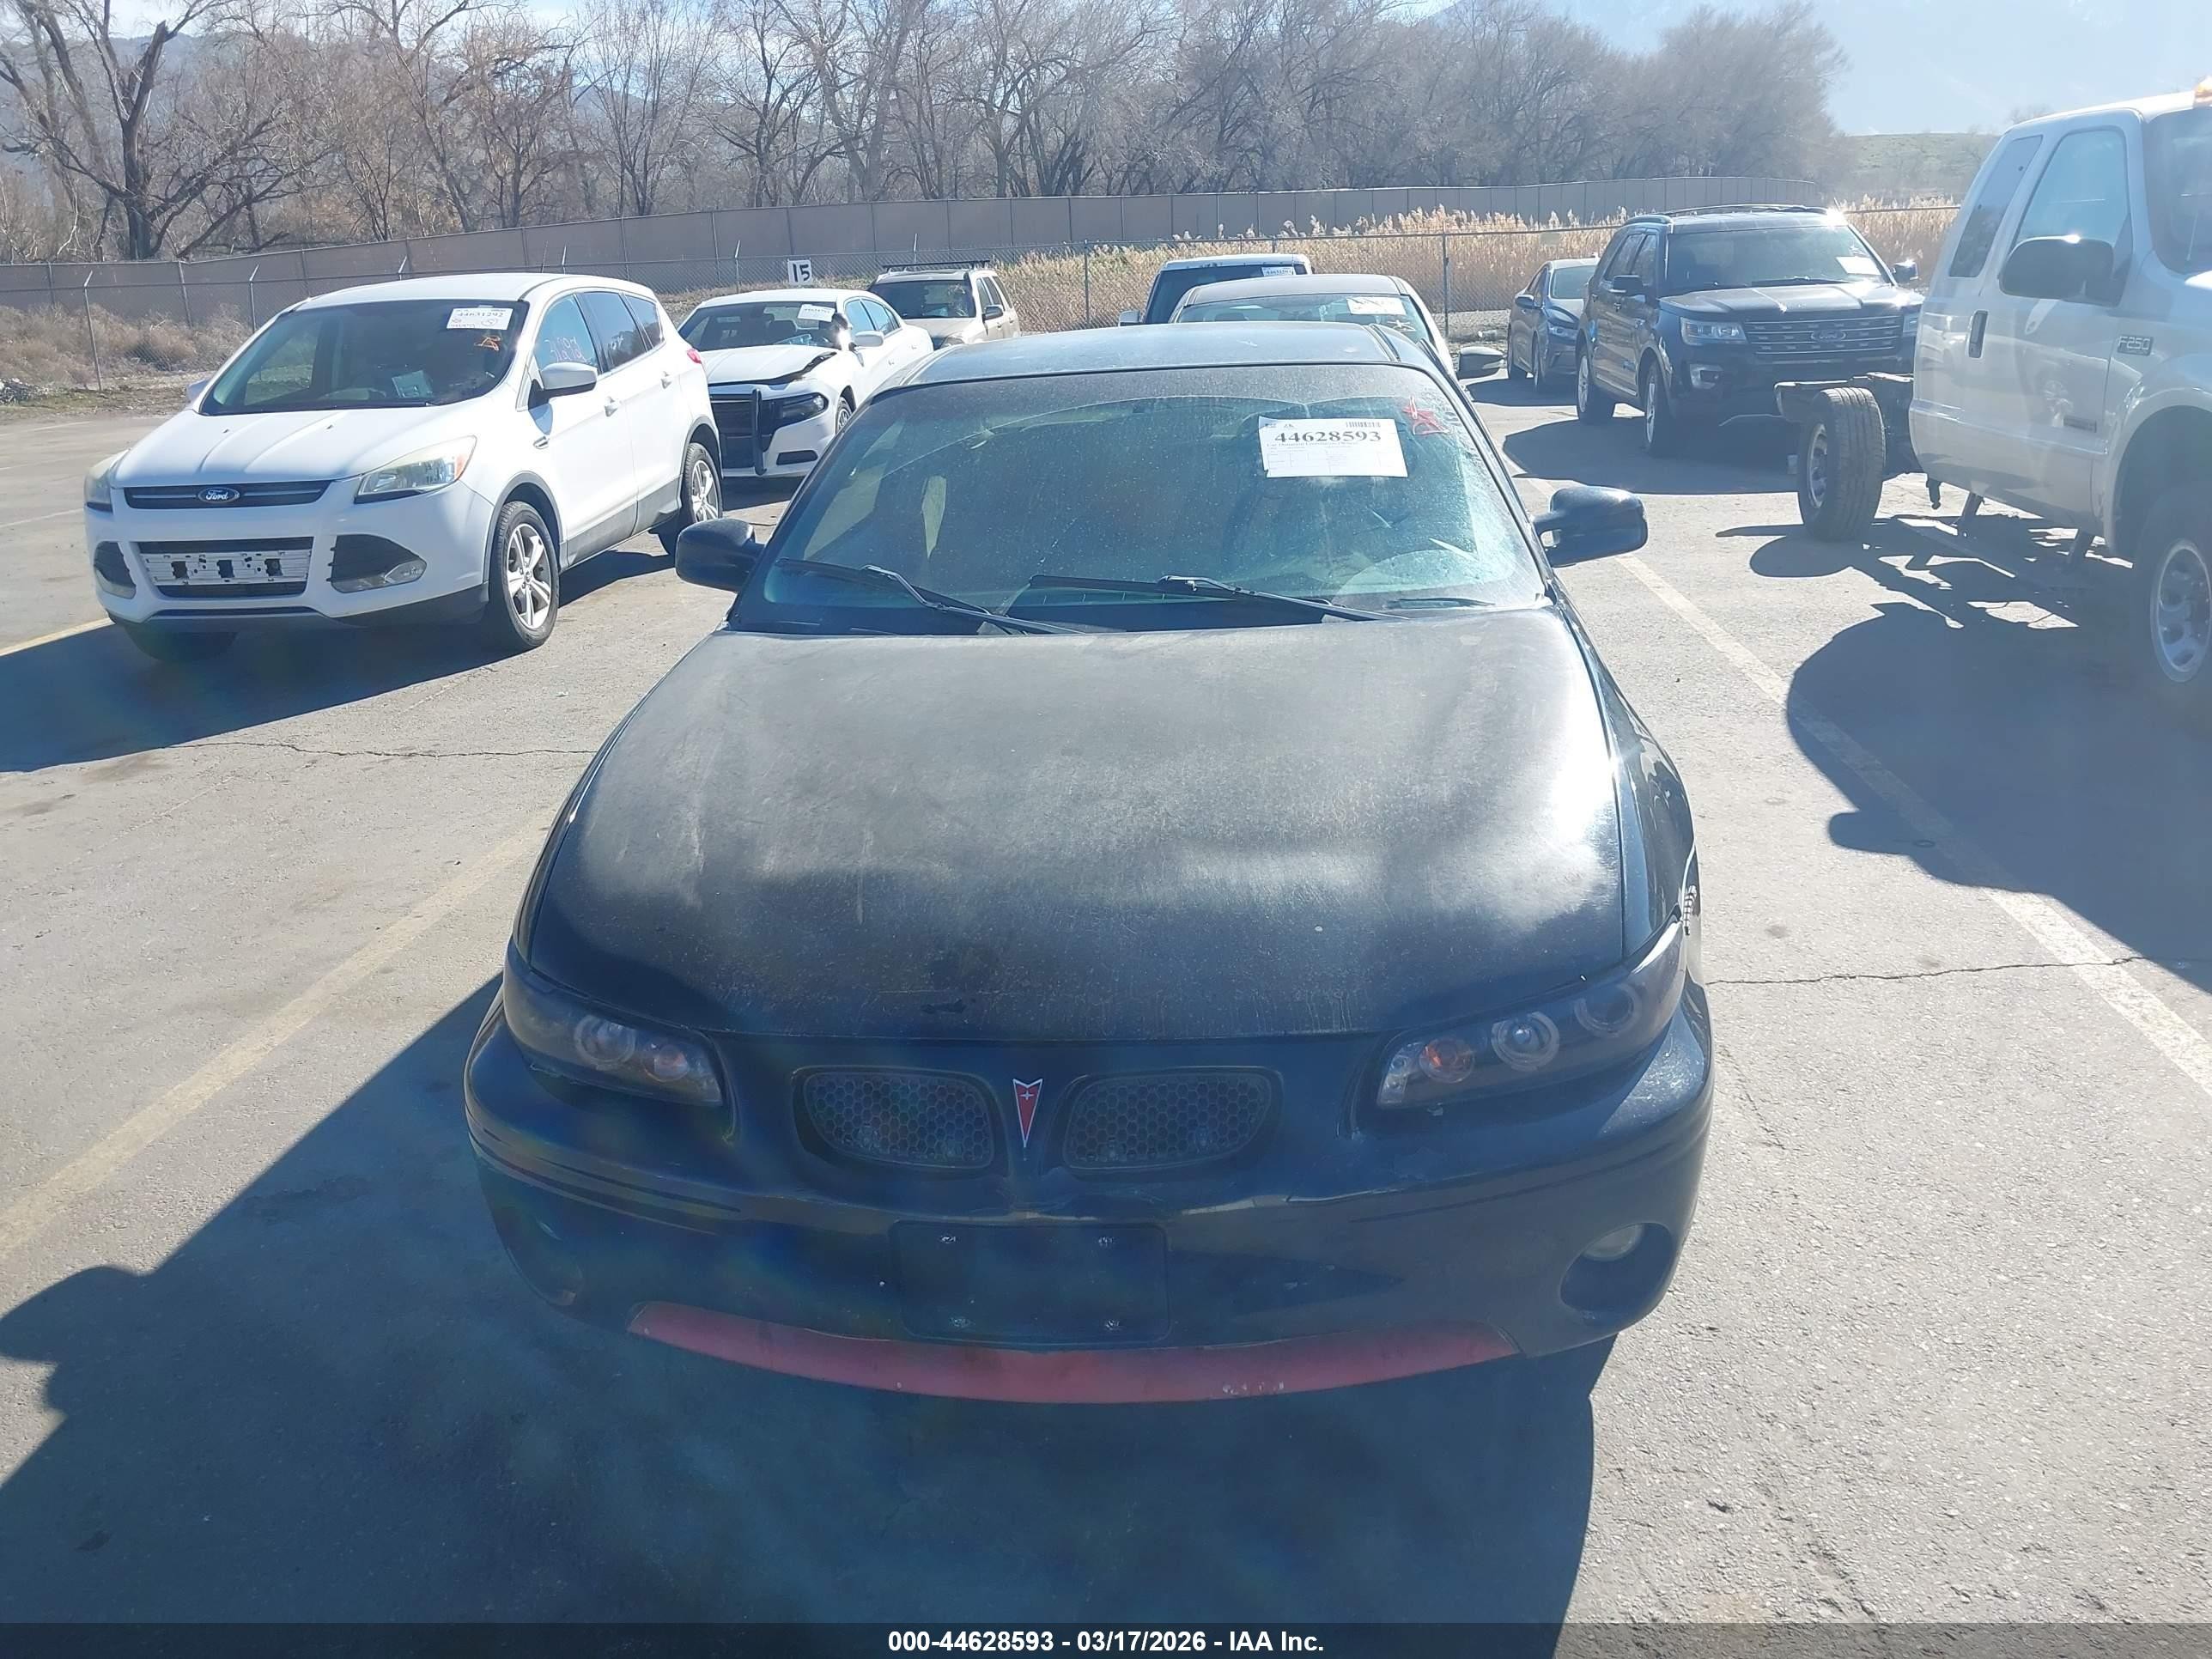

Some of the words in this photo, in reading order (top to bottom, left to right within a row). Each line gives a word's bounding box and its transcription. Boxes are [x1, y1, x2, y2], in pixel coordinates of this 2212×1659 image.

[793, 264, 810, 282] 15
[2118, 336, 2151, 350] F250
[1274, 431, 1381, 442] 44628593
[205, 489, 229, 501] Ford
